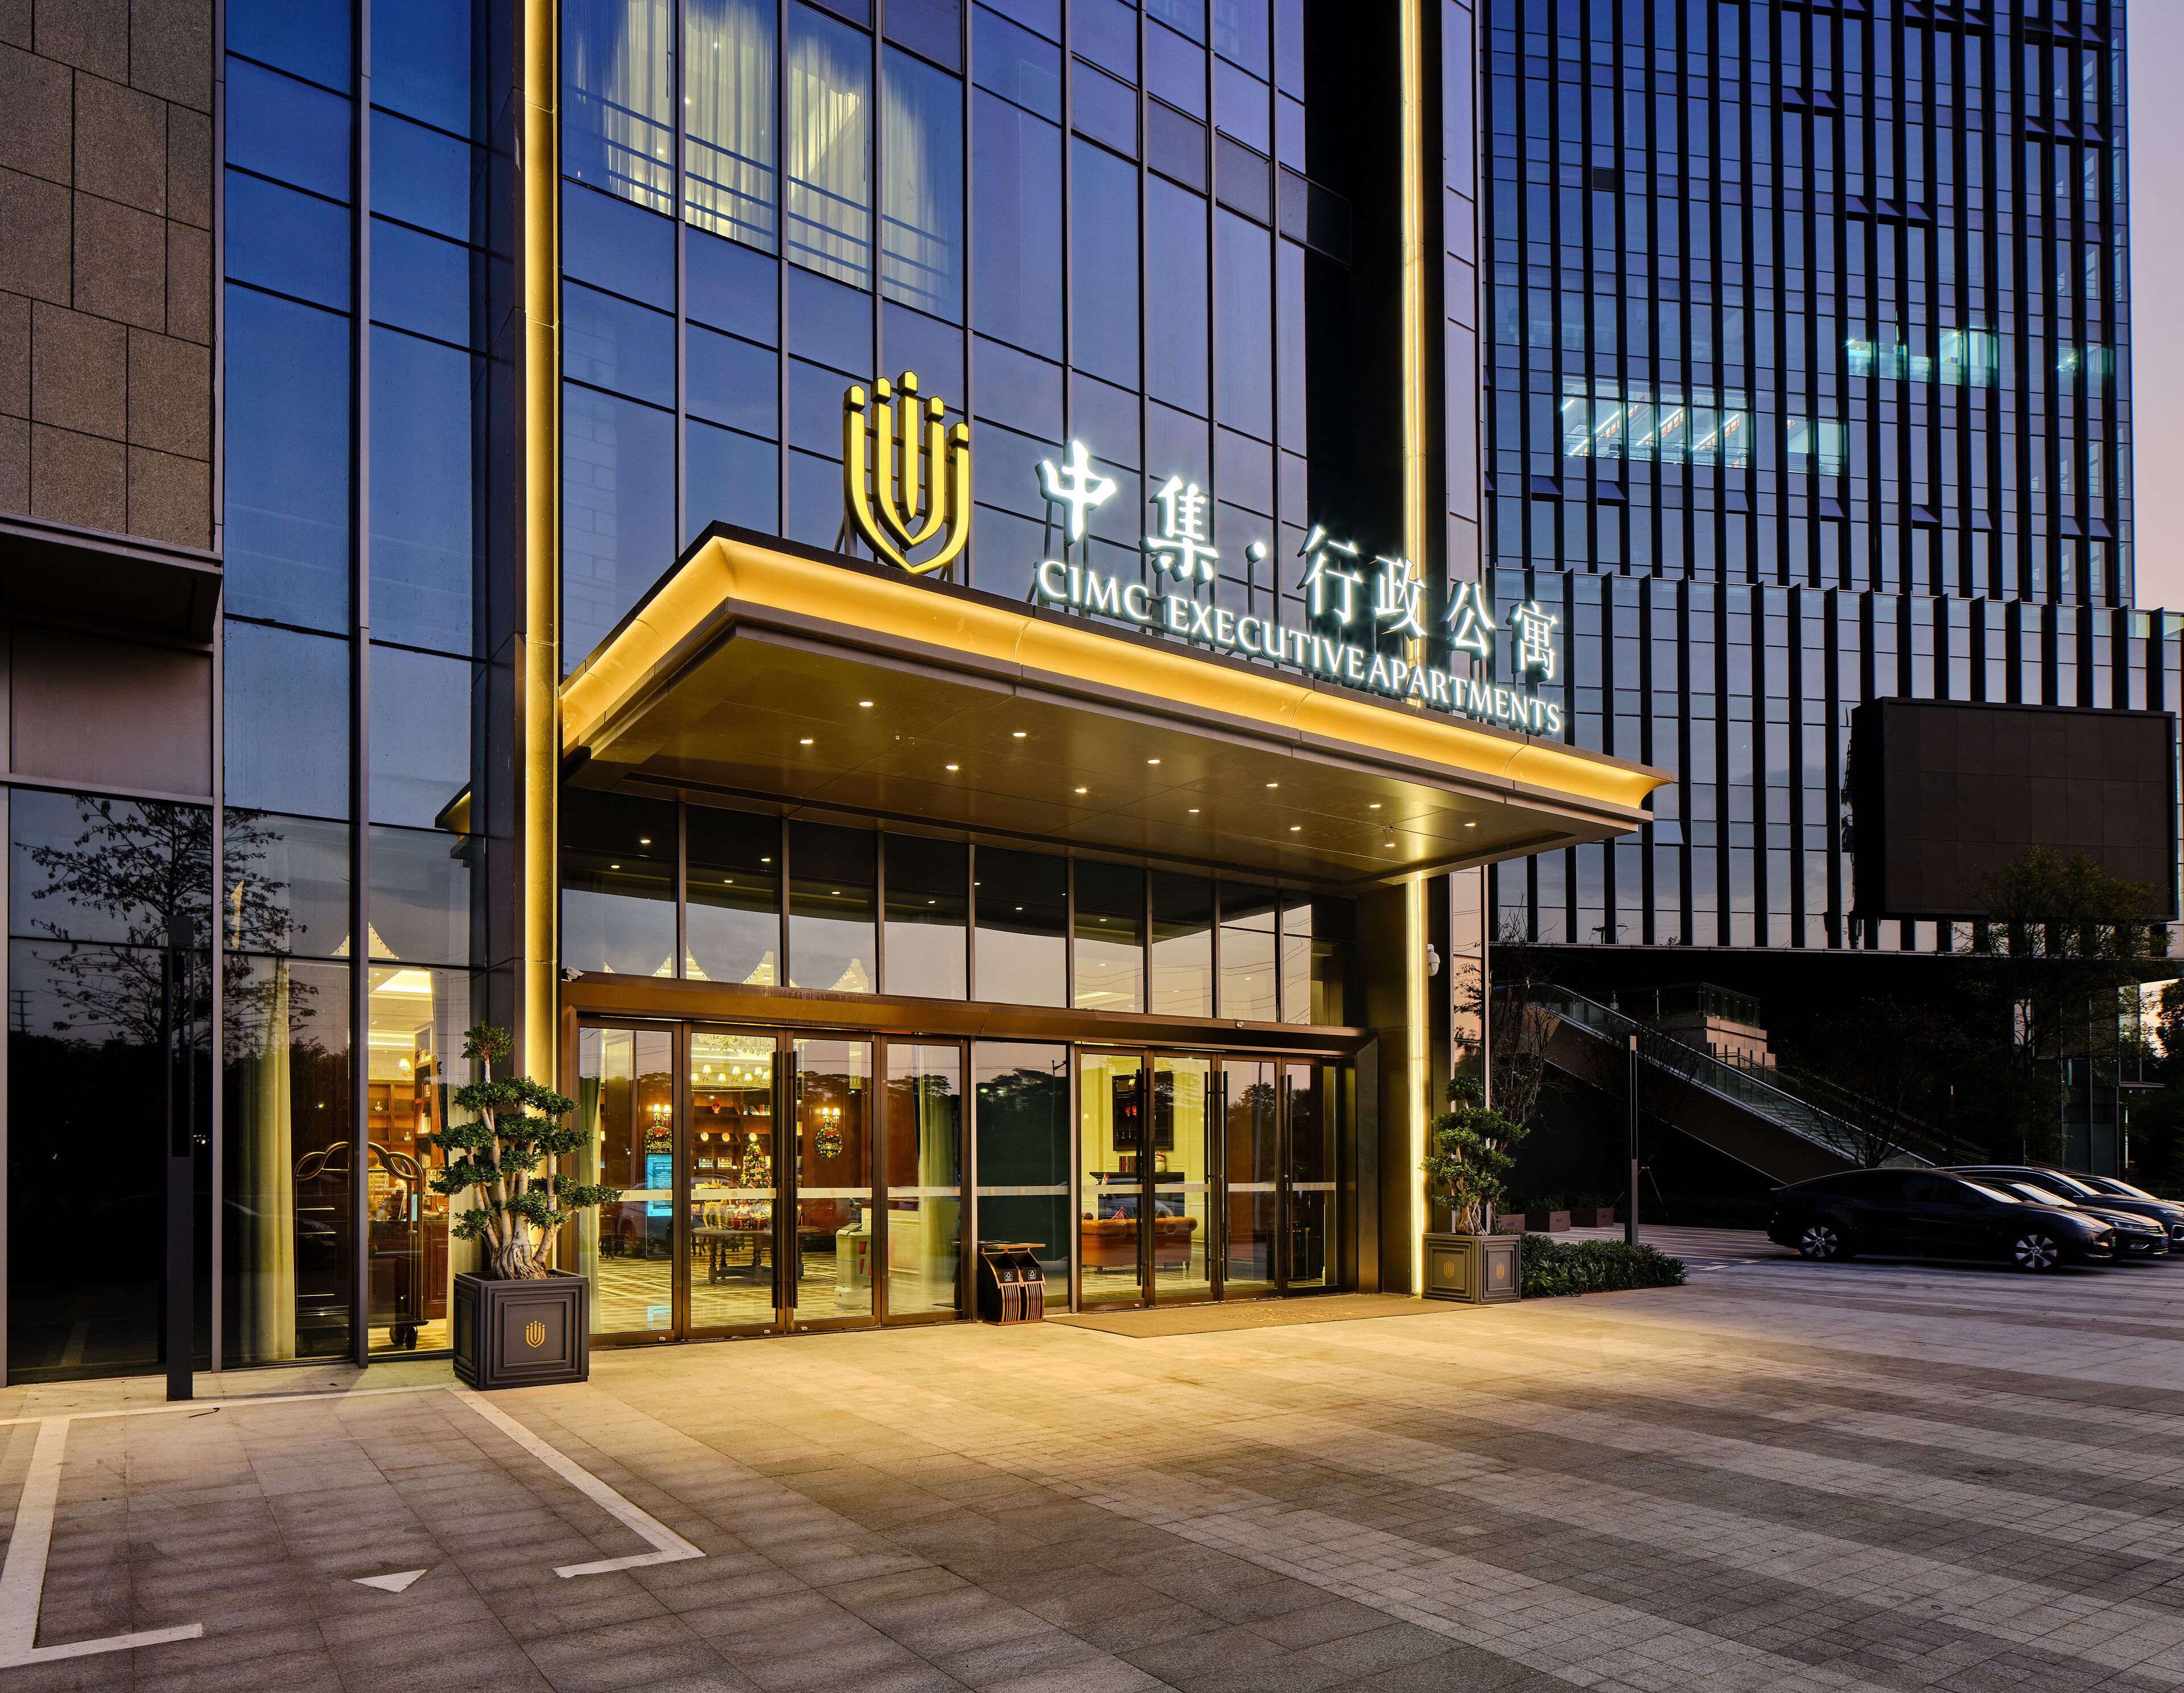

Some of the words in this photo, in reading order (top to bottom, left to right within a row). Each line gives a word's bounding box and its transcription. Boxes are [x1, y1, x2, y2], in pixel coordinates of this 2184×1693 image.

[1038, 559, 1151, 620] CIMC
[1167, 594, 1364, 680] EXECUTIVE
[1368, 654, 1561, 733] APARTMENTS
